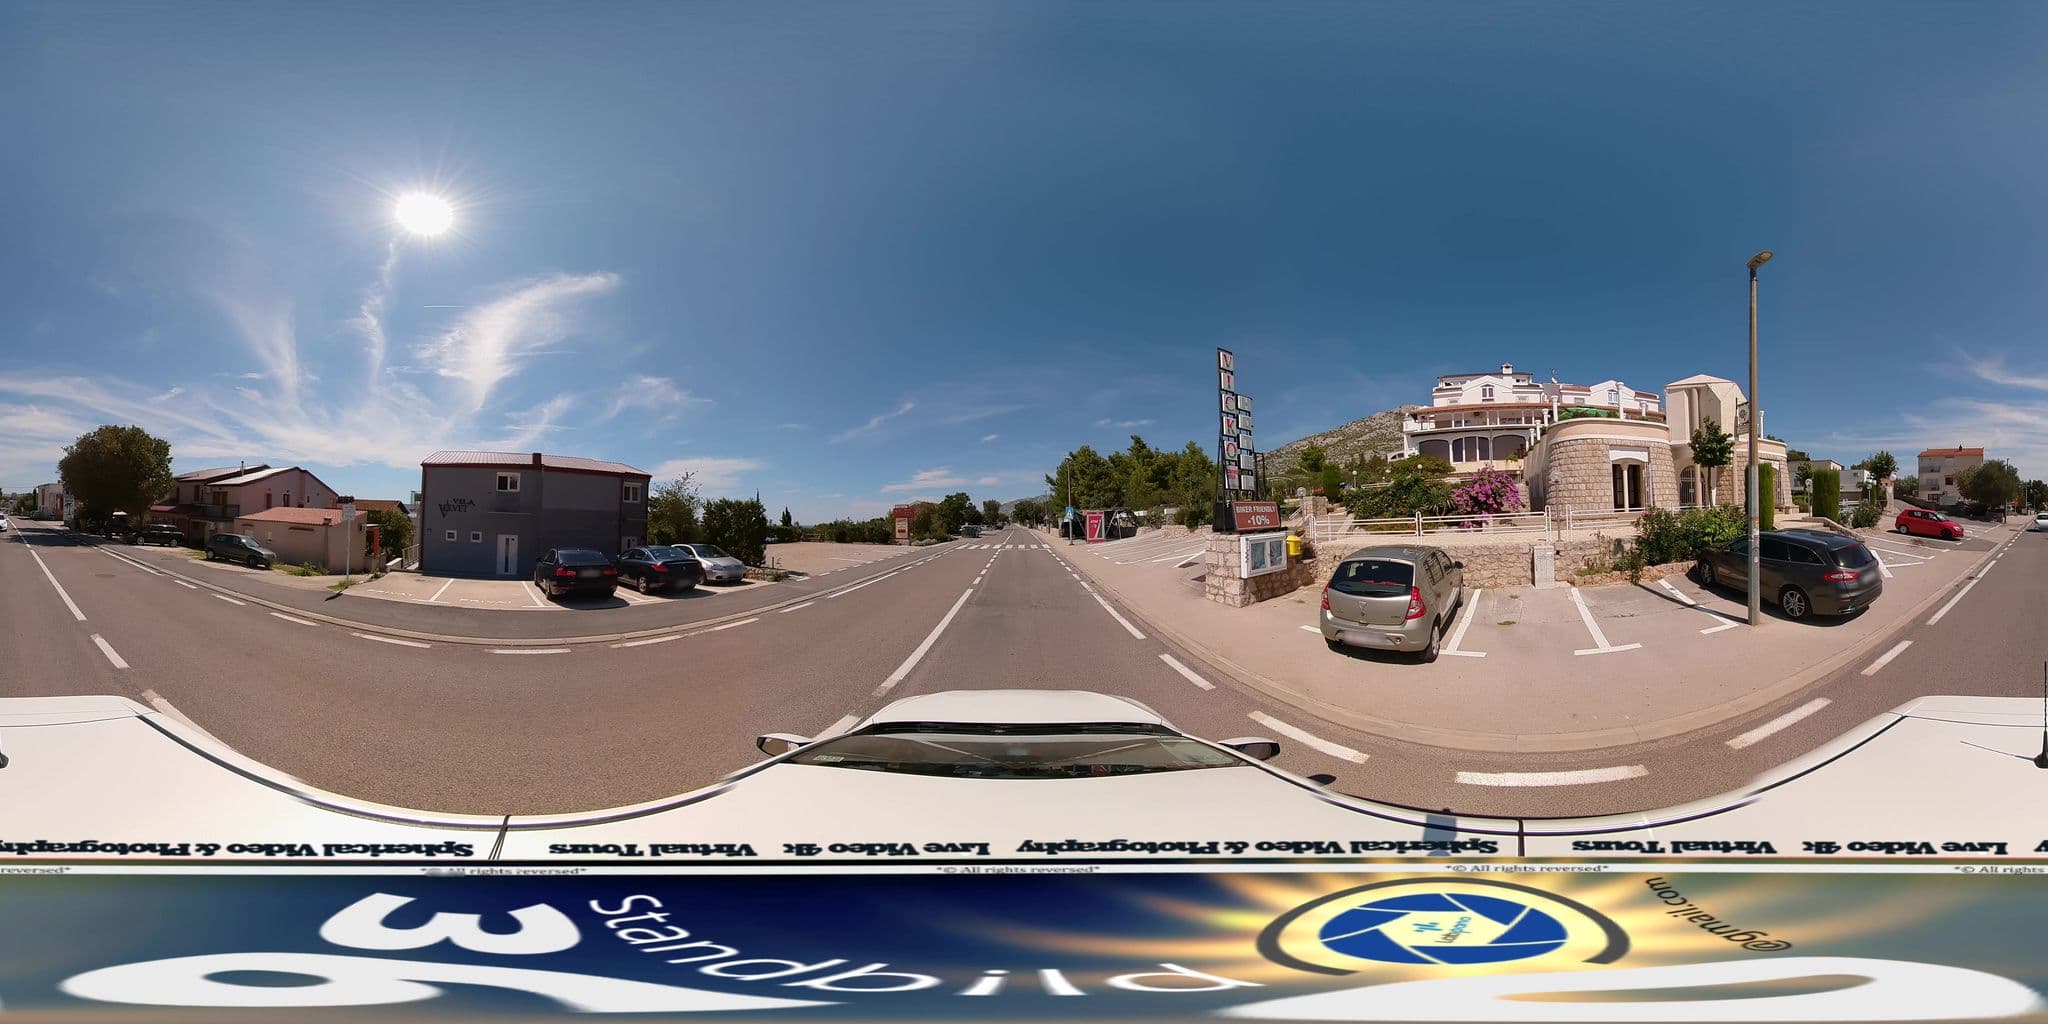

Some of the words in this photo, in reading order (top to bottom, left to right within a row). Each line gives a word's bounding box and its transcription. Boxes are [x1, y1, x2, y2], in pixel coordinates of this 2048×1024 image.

[1223, 354, 1237, 459] VICKO
[1253, 505, 1277, 513] FRIENDLY
[1247, 514, 1270, 526] -10%
